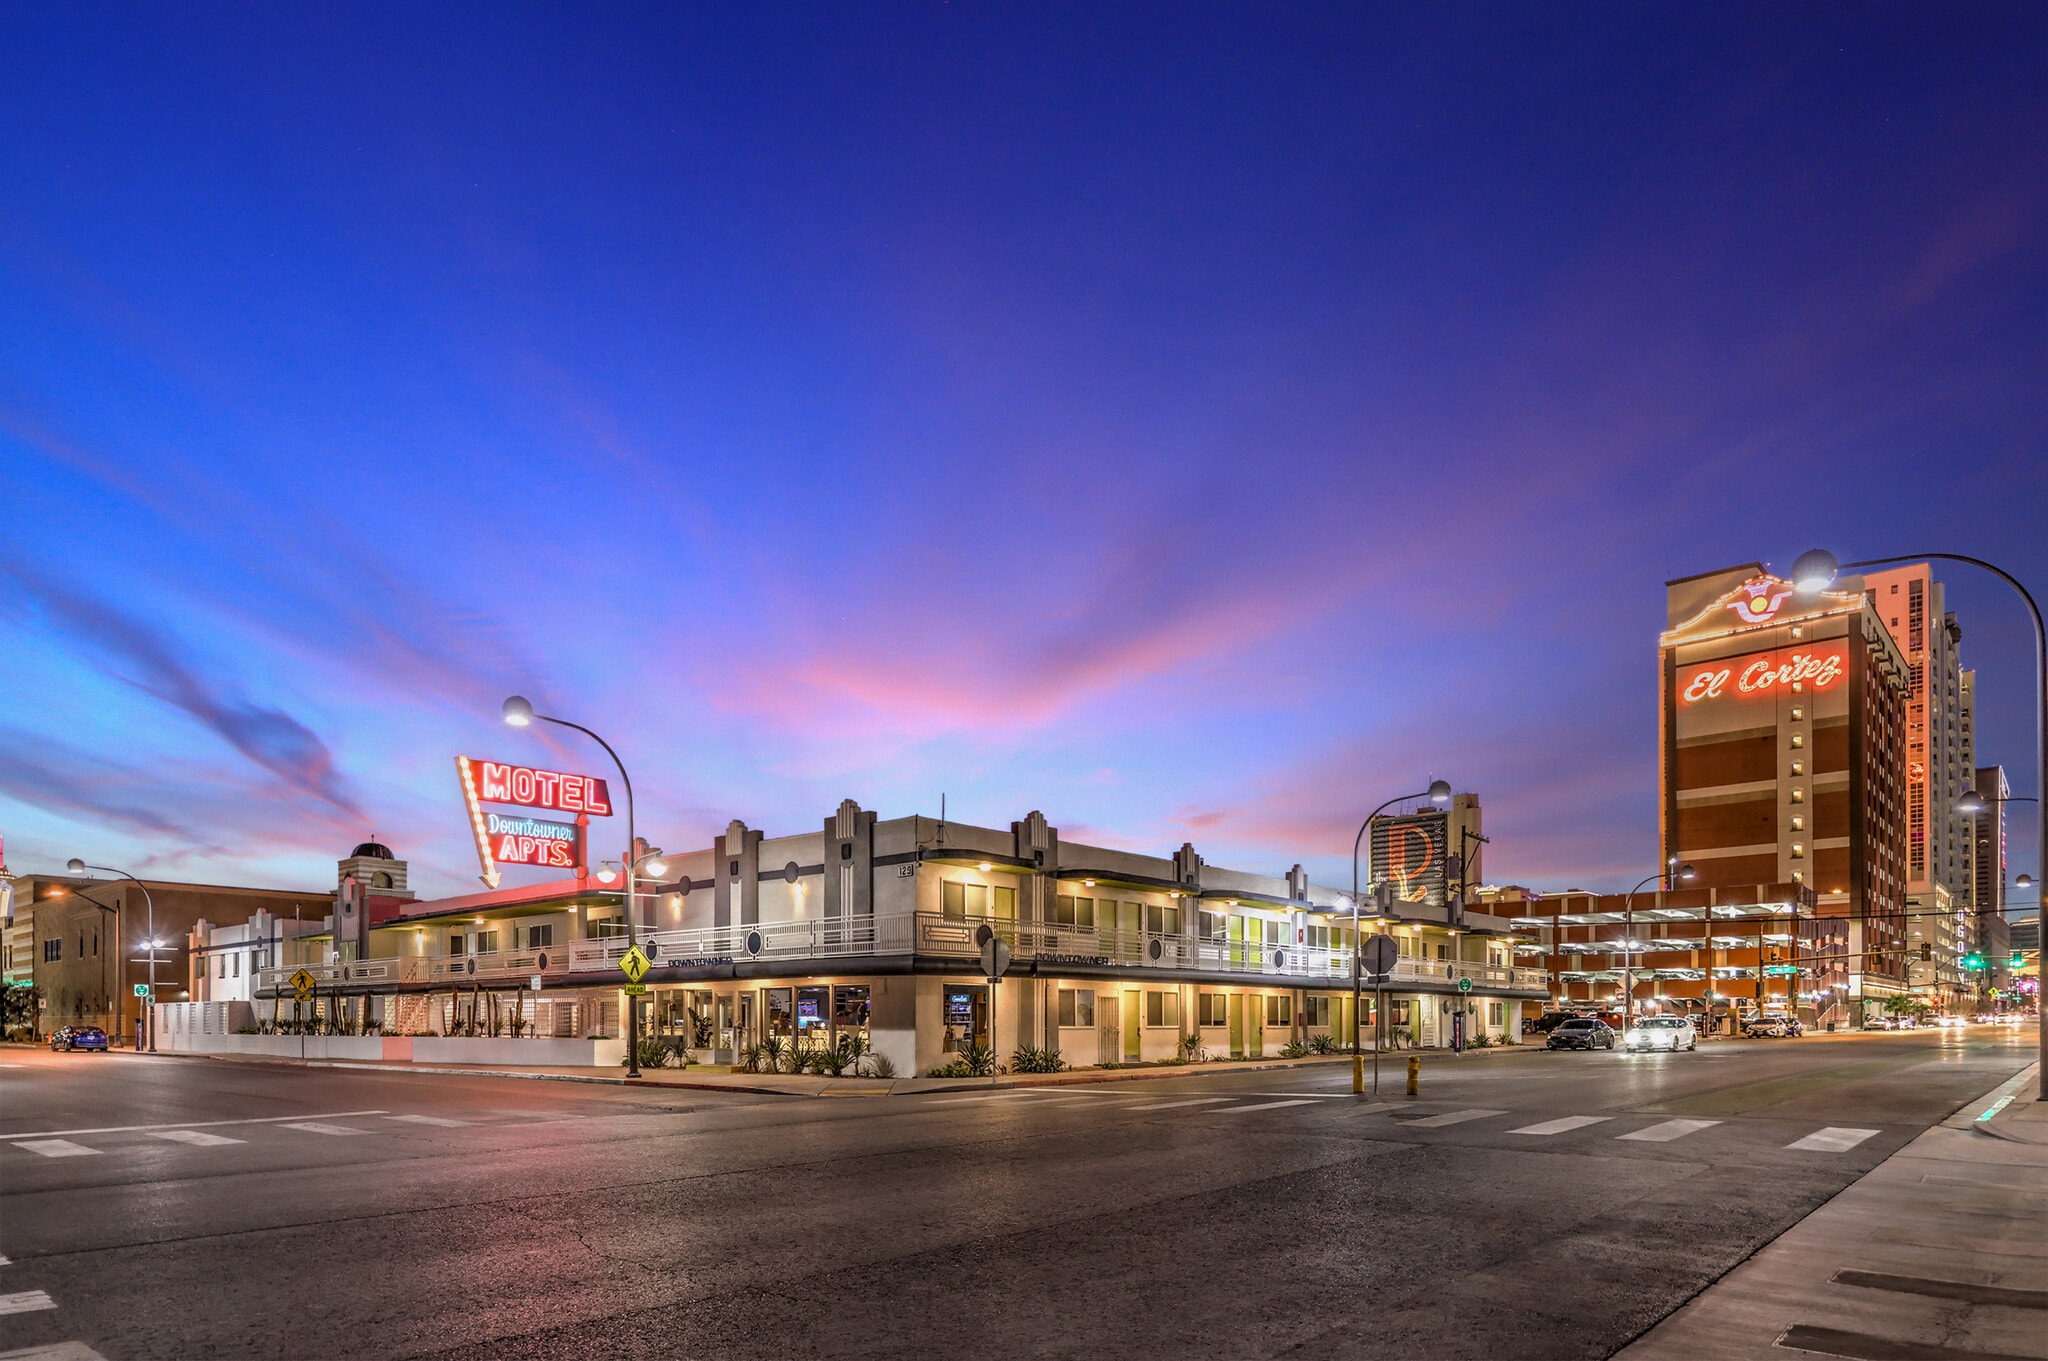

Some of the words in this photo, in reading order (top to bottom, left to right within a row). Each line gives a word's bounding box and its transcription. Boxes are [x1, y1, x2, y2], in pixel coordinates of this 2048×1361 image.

[1683, 669, 1731, 702] El
[1738, 654, 1843, 692] Cortez
[483, 762, 607, 814] MOTEL
[487, 813, 574, 841] Downtowner
[498, 835, 573, 866] APTS.
[899, 866, 912, 876] 129
[668, 956, 733, 968] DOWNTOWNER
[1035, 953, 1109, 965] DOWNTOWNER
